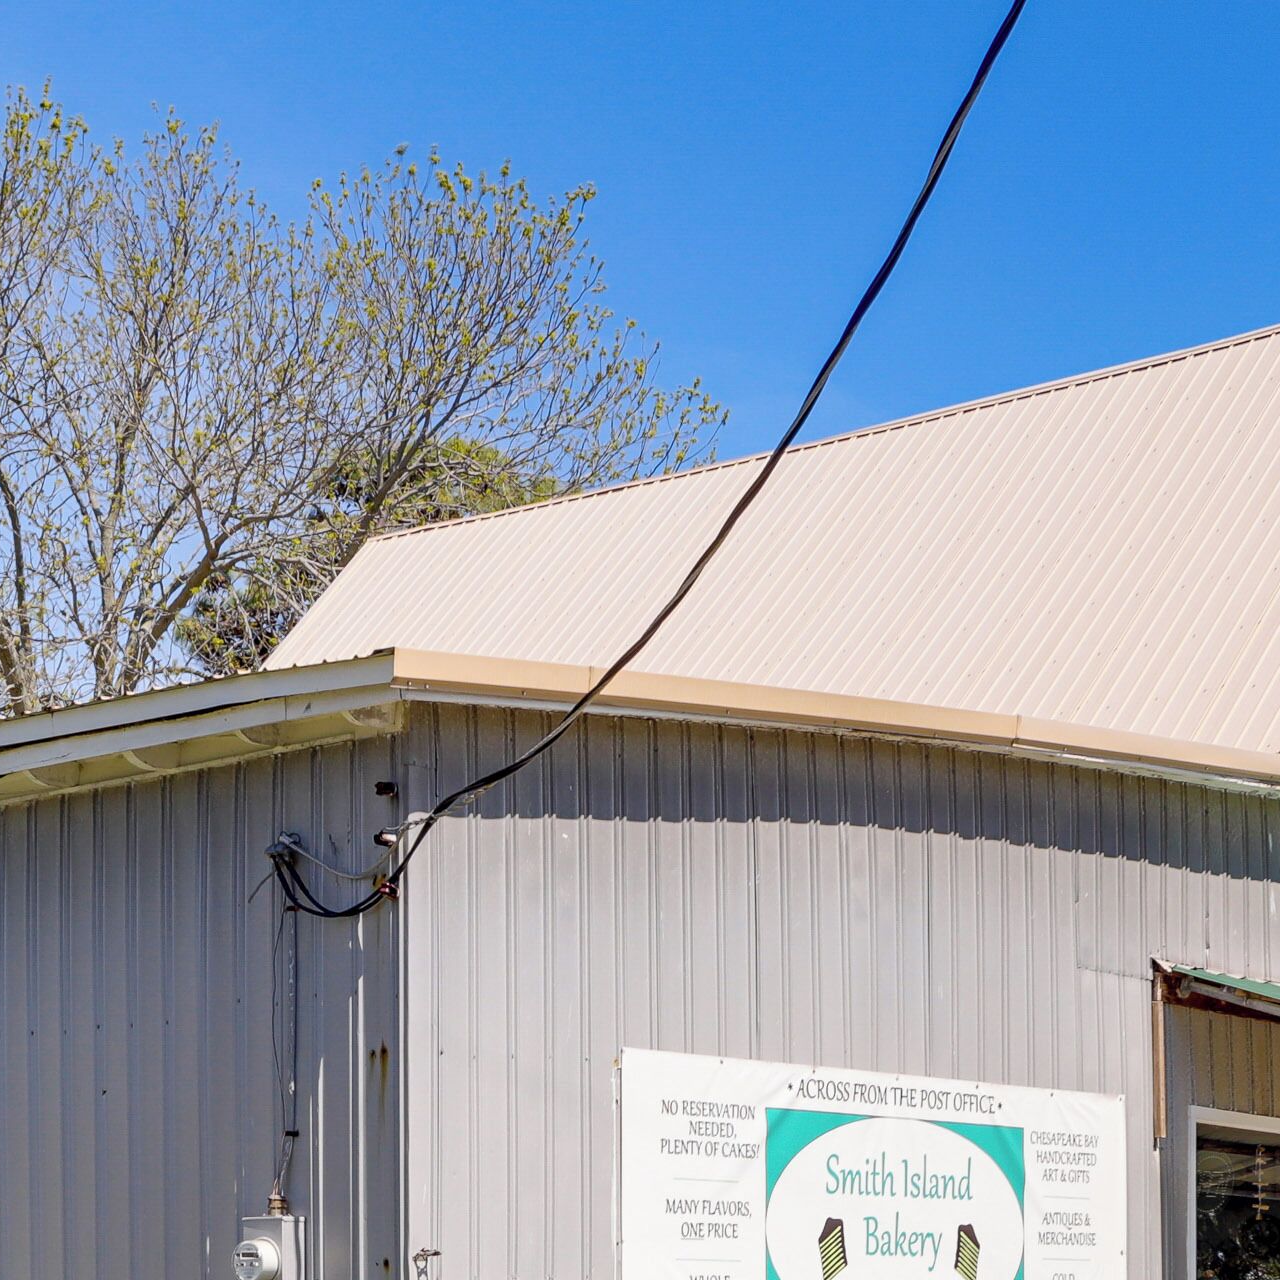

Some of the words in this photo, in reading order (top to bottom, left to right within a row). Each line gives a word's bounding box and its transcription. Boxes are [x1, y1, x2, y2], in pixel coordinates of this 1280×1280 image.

[796, 1078, 850, 1102] ACROSS
[852, 1083, 888, 1105] FROM
[890, 1087, 917, 1107] THE
[920, 1089, 951, 1110] POST
[953, 1092, 995, 1114] OFFICE
[661, 1099, 678, 1115] NO
[682, 1100, 755, 1120] RESERVATION
[689, 1120, 737, 1139] NEEDED,
[1030, 1130, 1083, 1147] CHESAPEAKE
[1084, 1134, 1099, 1148] BAY
[660, 1138, 702, 1155] PLENTY
[705, 1141, 719, 1156] OF
[721, 1142, 760, 1159] CAKES!
[1036, 1150, 1097, 1166] HANDCRAFTED
[826, 1151, 896, 1197] Smith
[902, 1153, 973, 1200] Island
[1042, 1168, 1059, 1182] ART
[1060, 1169, 1067, 1182] &
[1068, 1169, 1090, 1183] GIFTS
[665, 1199, 699, 1214] MANY
[702, 1200, 752, 1218] FLAVORS,
[681, 1222, 705, 1239] ONE
[708, 1223, 738, 1239] PRICE
[1042, 1212, 1082, 1230] ANTIQUES
[1084, 1213, 1090, 1226] &
[863, 1211, 942, 1272] Bakery
[1038, 1231, 1096, 1246] MERCHANDISE
